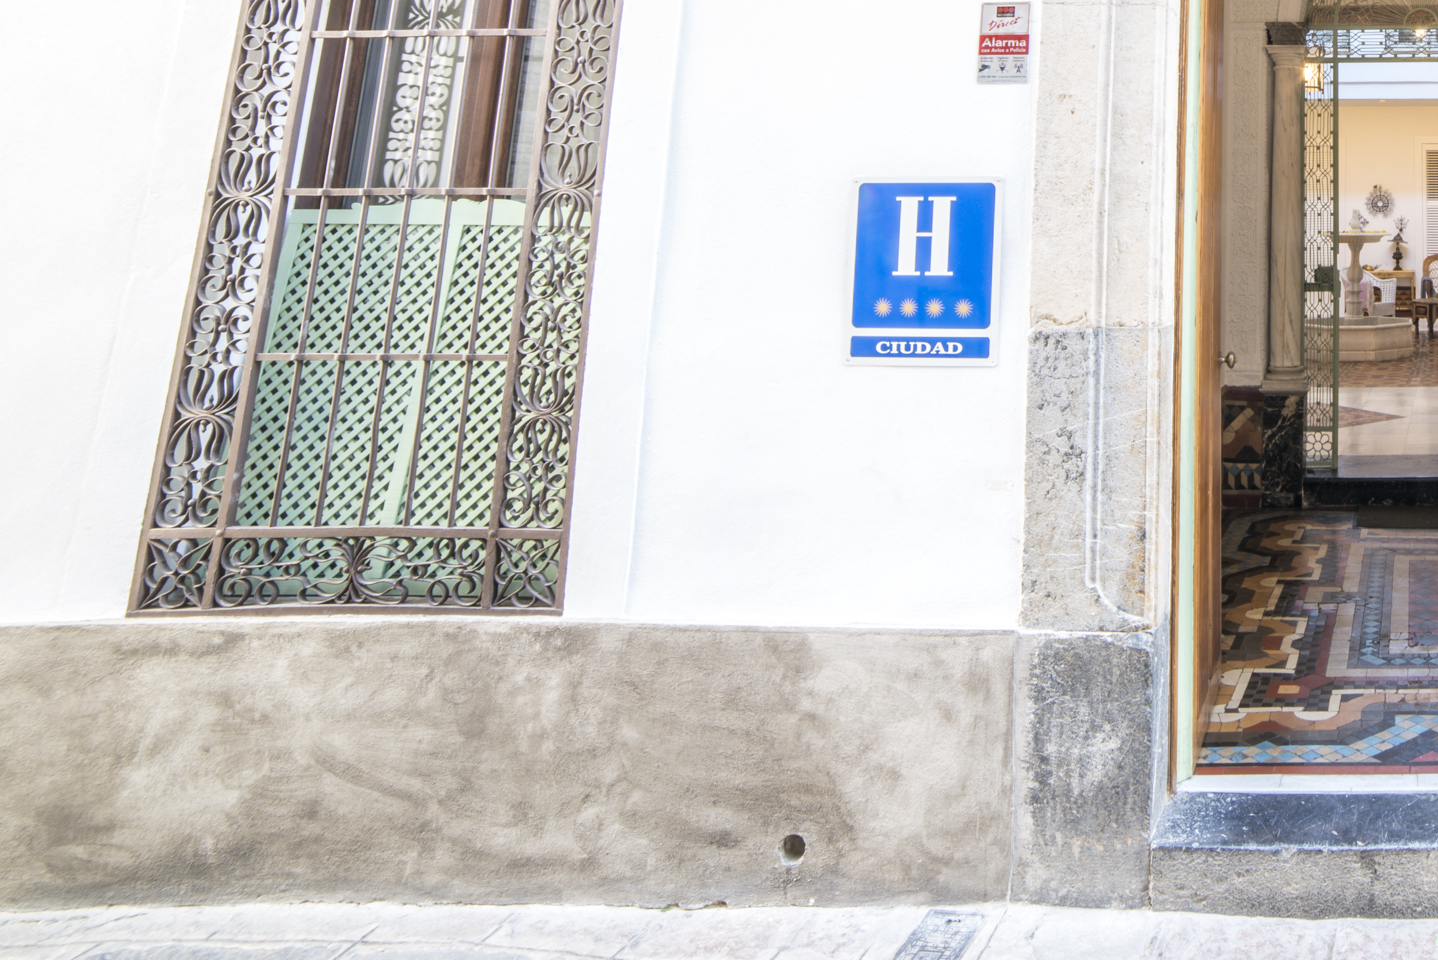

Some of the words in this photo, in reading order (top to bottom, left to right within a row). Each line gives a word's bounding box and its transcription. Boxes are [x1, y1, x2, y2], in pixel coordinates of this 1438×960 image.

[988, 16, 1023, 31] Direct
[981, 37, 1027, 47] Alarma
[892, 196, 957, 276] H
[875, 340, 963, 355] CIUDAD
